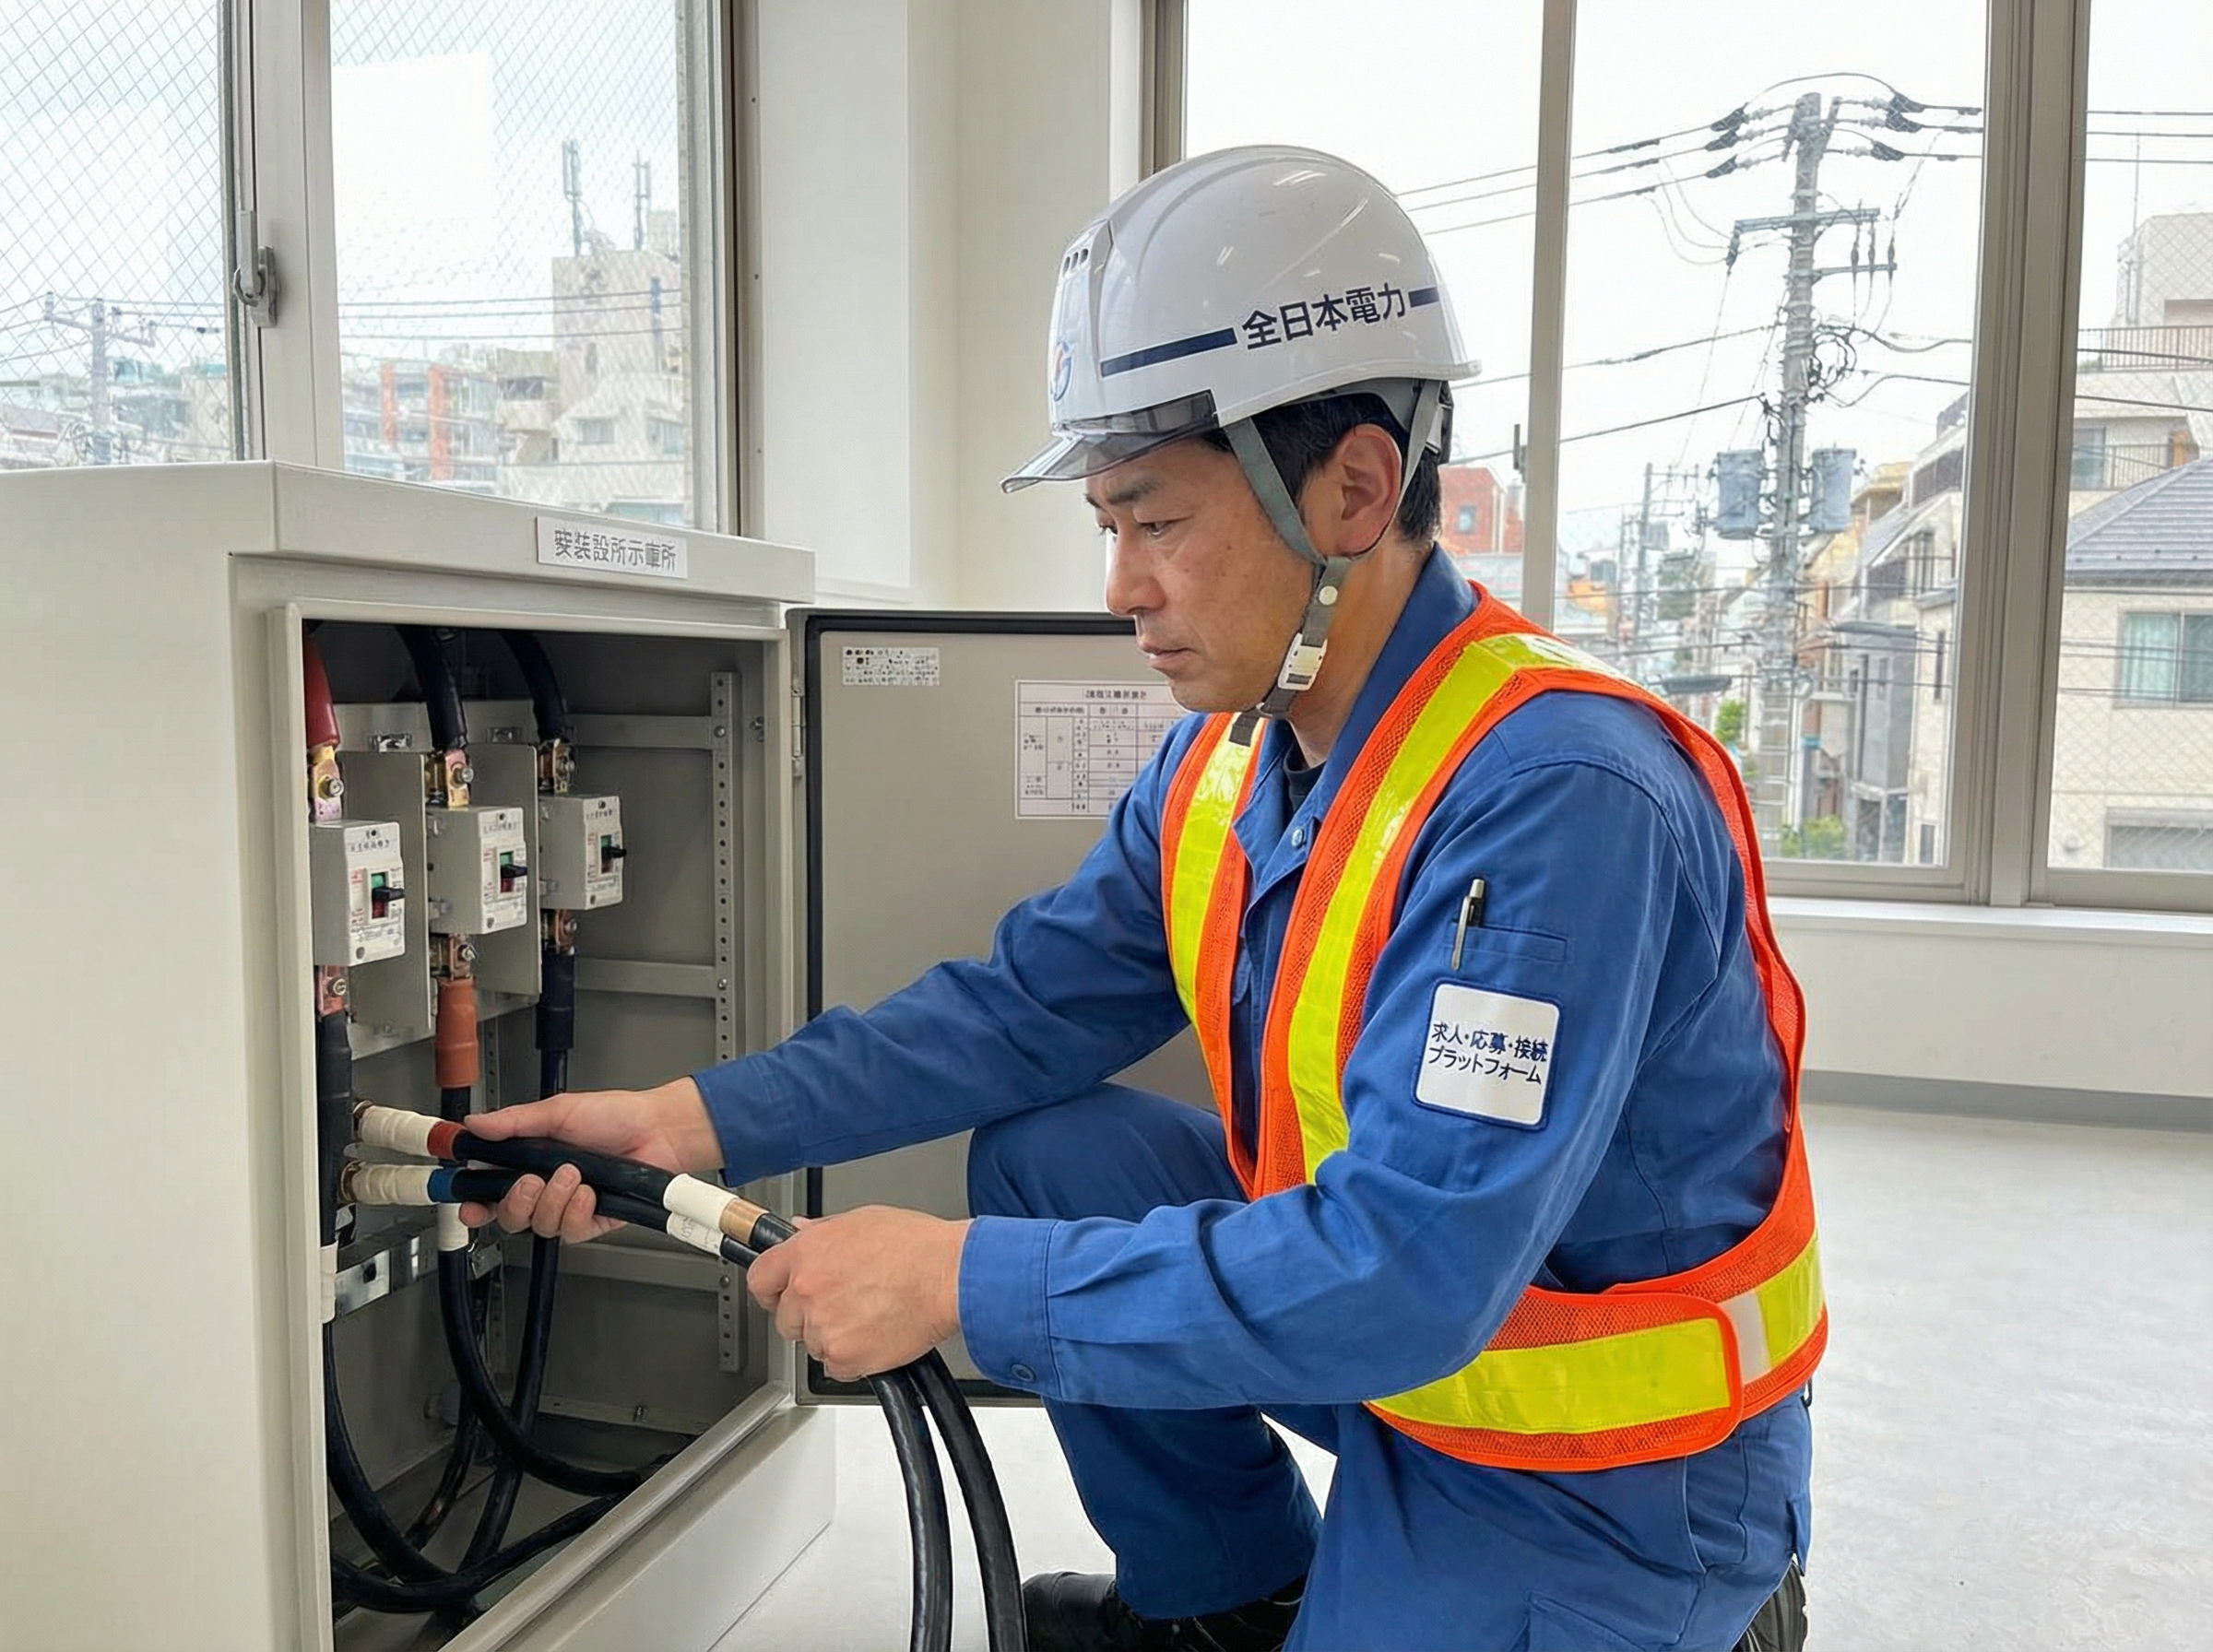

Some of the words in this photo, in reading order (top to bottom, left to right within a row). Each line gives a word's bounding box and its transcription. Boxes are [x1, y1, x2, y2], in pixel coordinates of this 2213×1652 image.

[1242, 282, 1405, 350] 全日本電力
[1428, 1045, 1542, 1085] プラットフォーム
